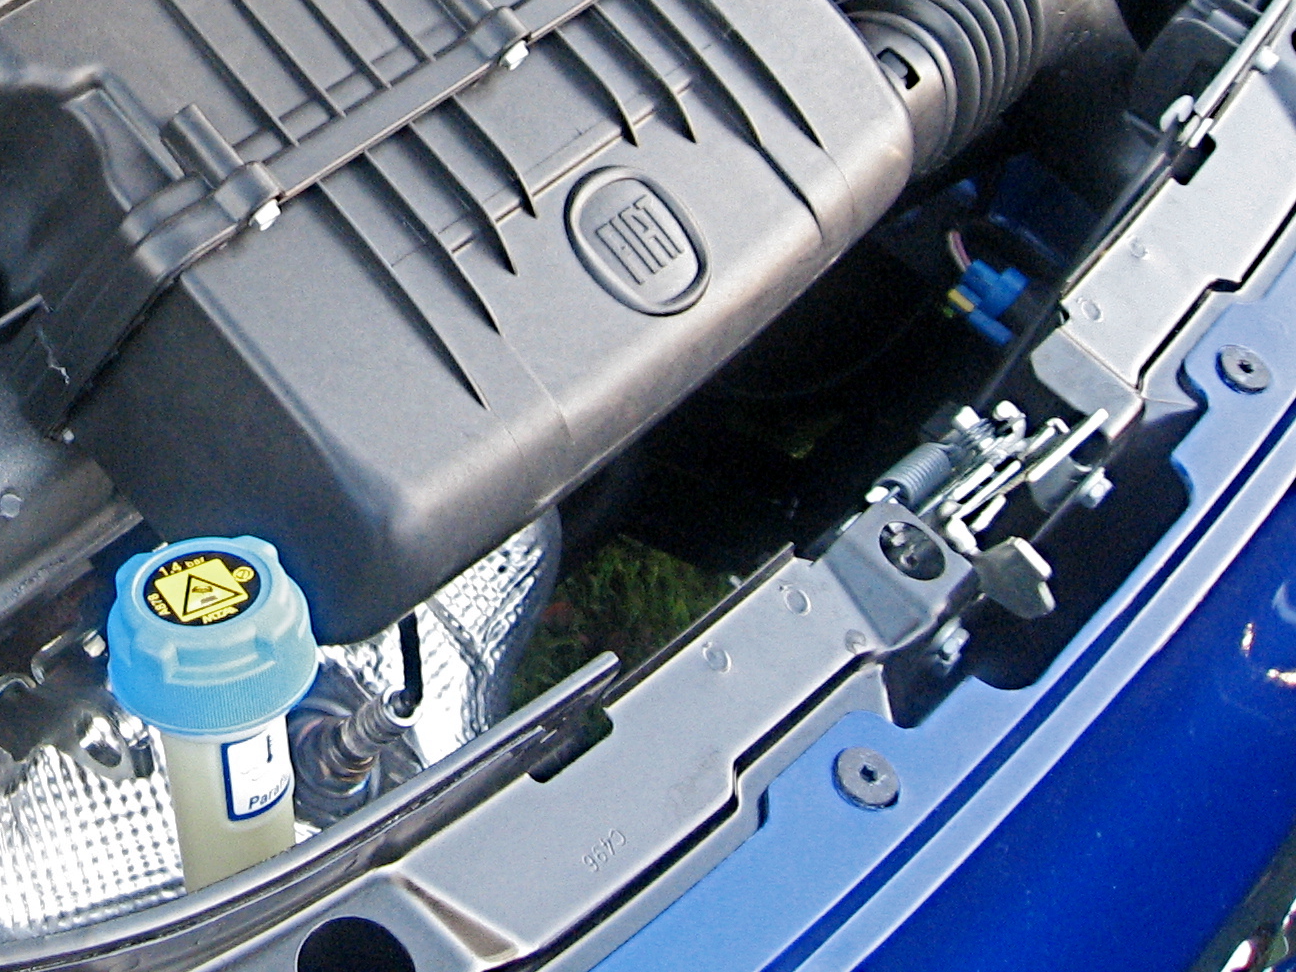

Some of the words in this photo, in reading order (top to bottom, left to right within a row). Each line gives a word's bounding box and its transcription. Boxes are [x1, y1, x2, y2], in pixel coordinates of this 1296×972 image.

[594, 194, 684, 286] FIAT
[158, 560, 183, 576] 1.4
[184, 556, 206, 569] bar
[581, 828, 627, 872] C496
